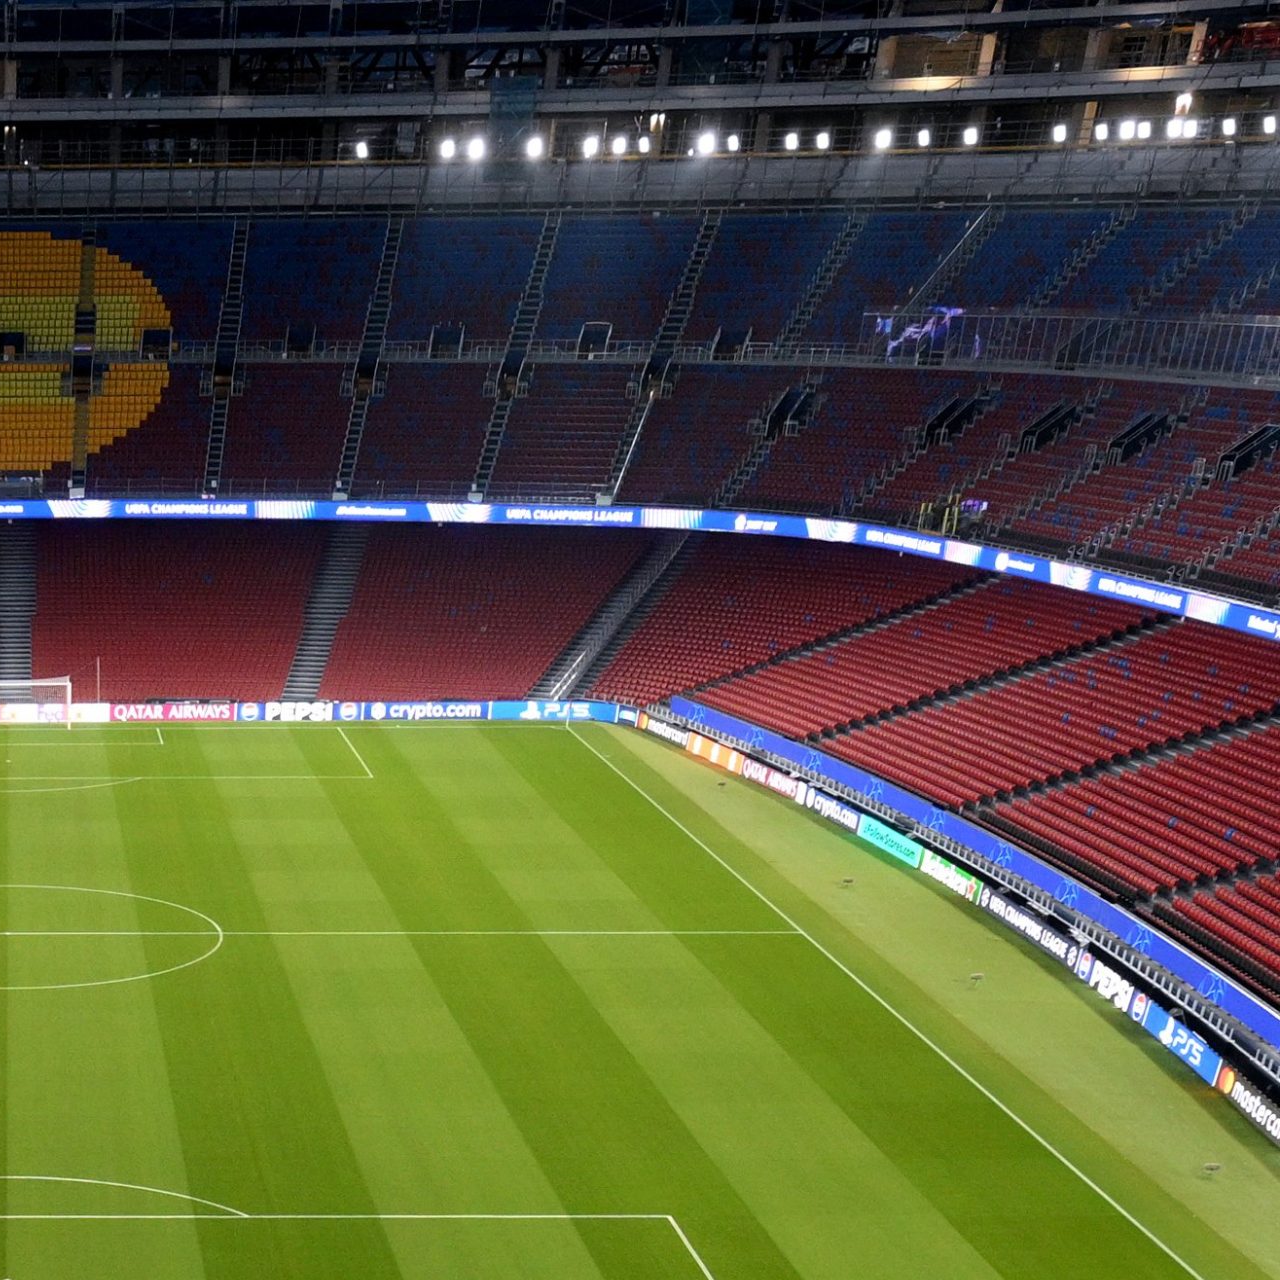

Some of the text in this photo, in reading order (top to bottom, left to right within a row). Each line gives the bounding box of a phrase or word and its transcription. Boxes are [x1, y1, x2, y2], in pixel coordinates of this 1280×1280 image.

[125, 503, 248, 515] UEFA CHAMPIONS LEAGUE
[506, 508, 633, 522] UEFA CHAMPIONS LEAGUE
[114, 704, 230, 722] QATAR AIRWAYS
[266, 702, 333, 721] PEPSI
[389, 702, 482, 720] crypto.com
[544, 703, 591, 718] PS5
[742, 759, 767, 784] QATAR
[814, 795, 858, 829] crypto.com
[989, 894, 1069, 959] UEFA CHAMPIONS LEAGUE
[1089, 959, 1134, 1013] PEPSI
[1172, 1028, 1204, 1067] PS5
